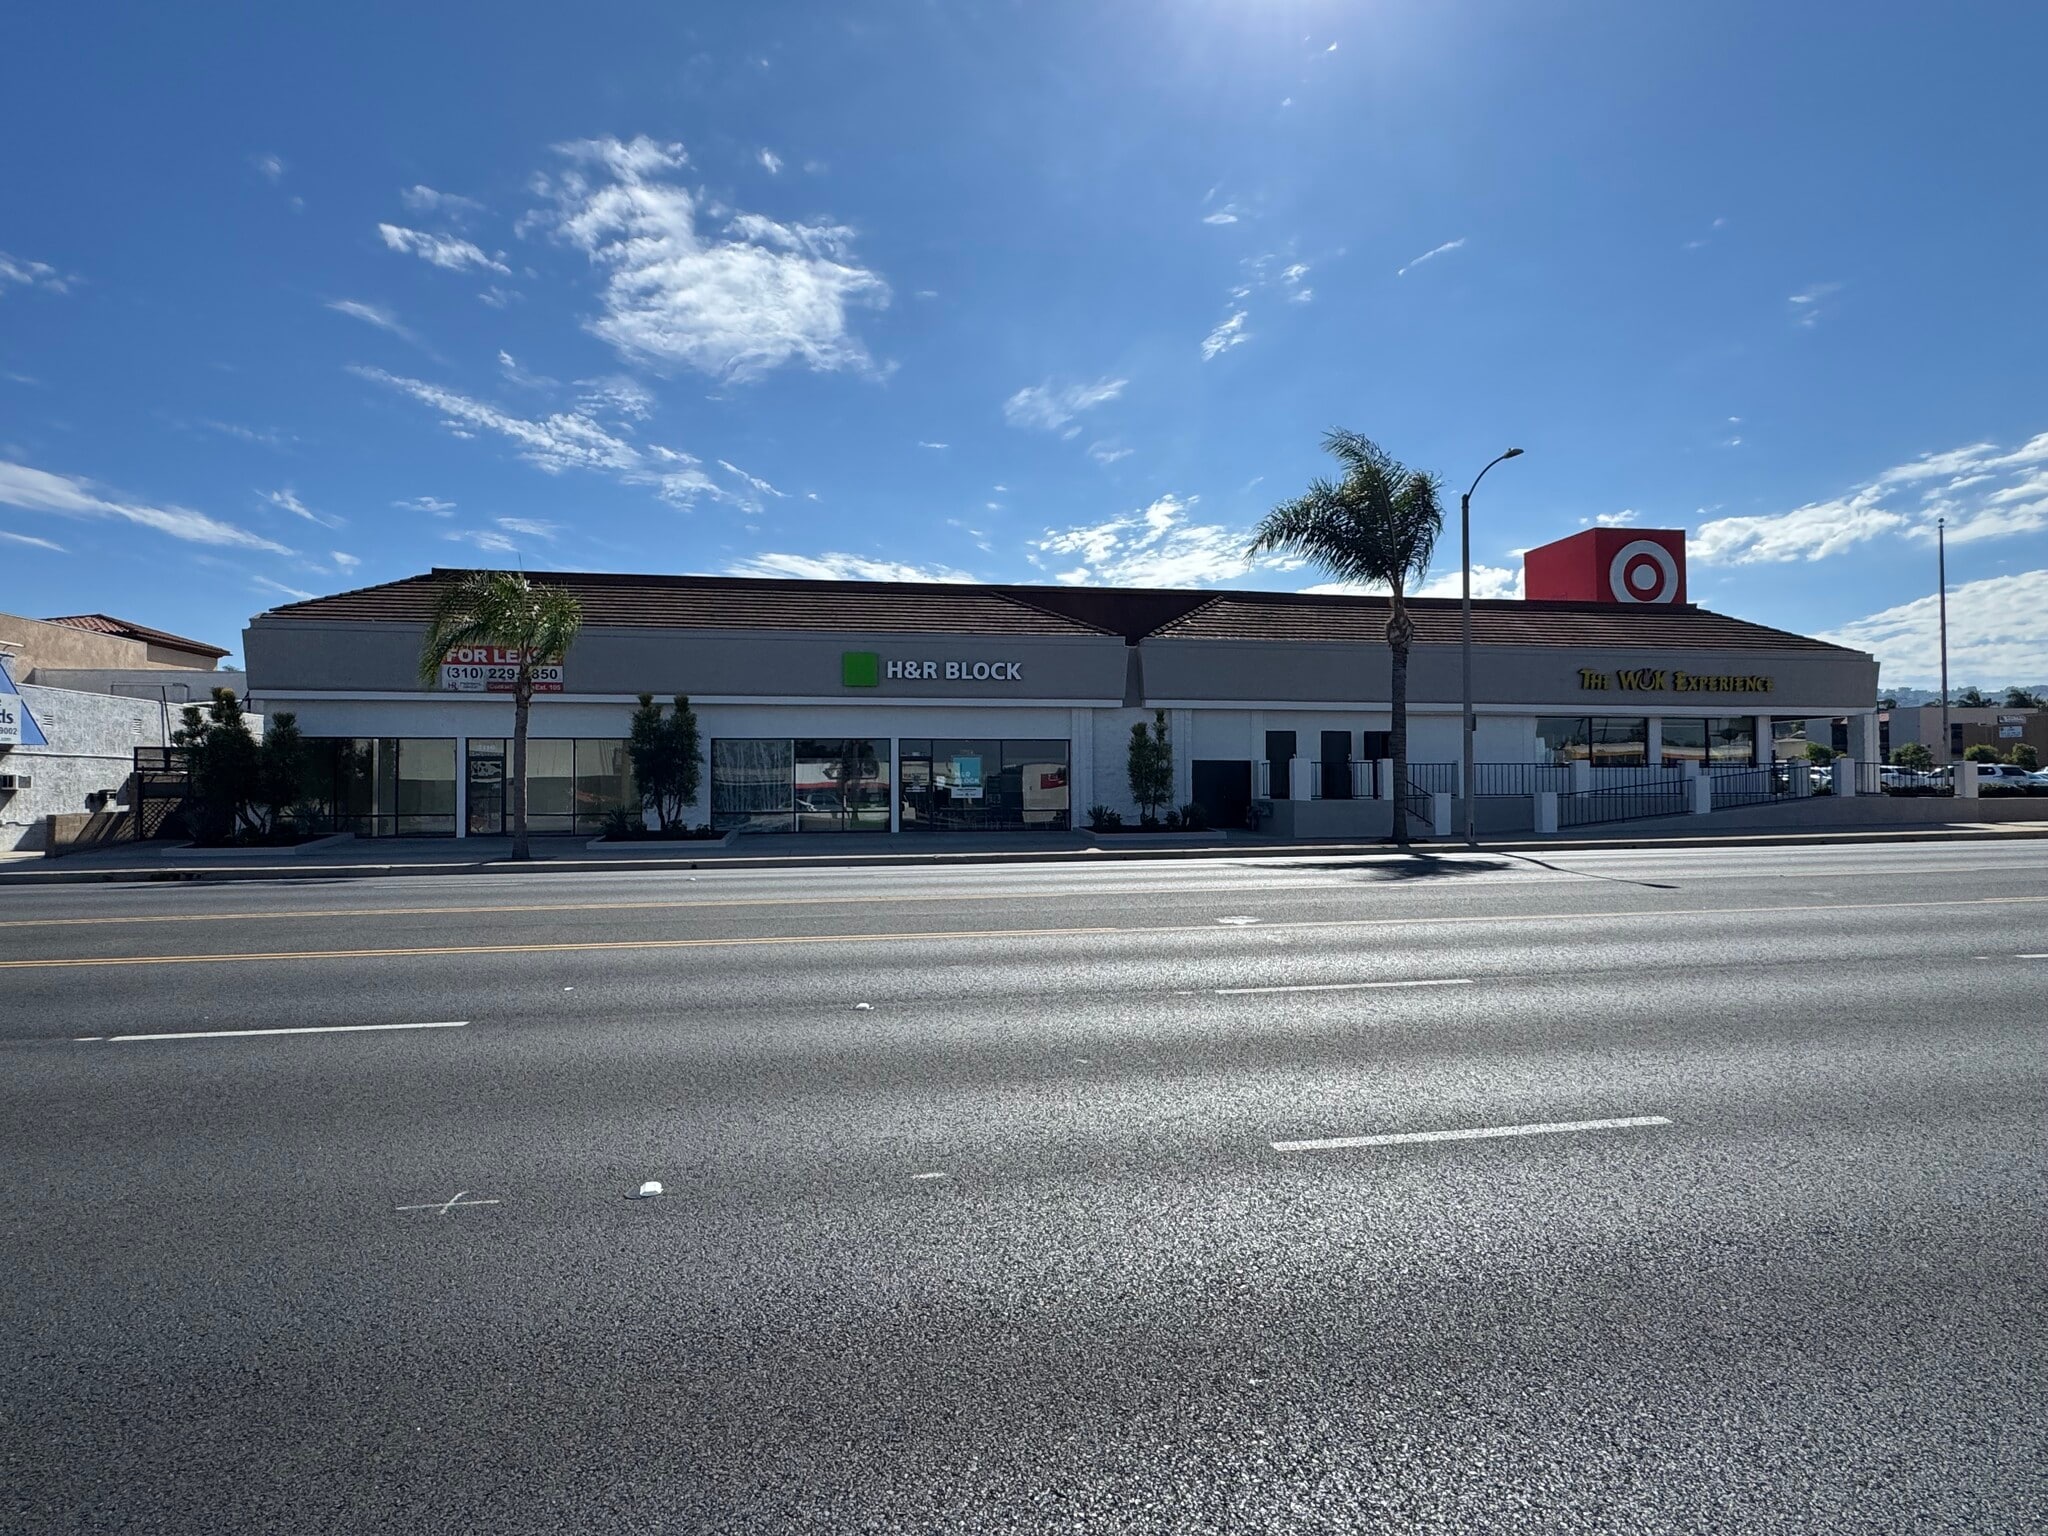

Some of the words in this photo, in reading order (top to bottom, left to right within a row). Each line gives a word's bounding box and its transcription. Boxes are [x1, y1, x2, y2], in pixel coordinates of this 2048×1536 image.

[446, 648, 488, 663] FOR
[447, 667, 483, 680] (310)
[488, 668, 558, 681] 229-850
[887, 660, 938, 679] H&R
[945, 661, 1022, 680] BLOCK
[1617, 668, 1668, 691] WOK
[1674, 671, 1775, 692] EXPERIENCE
